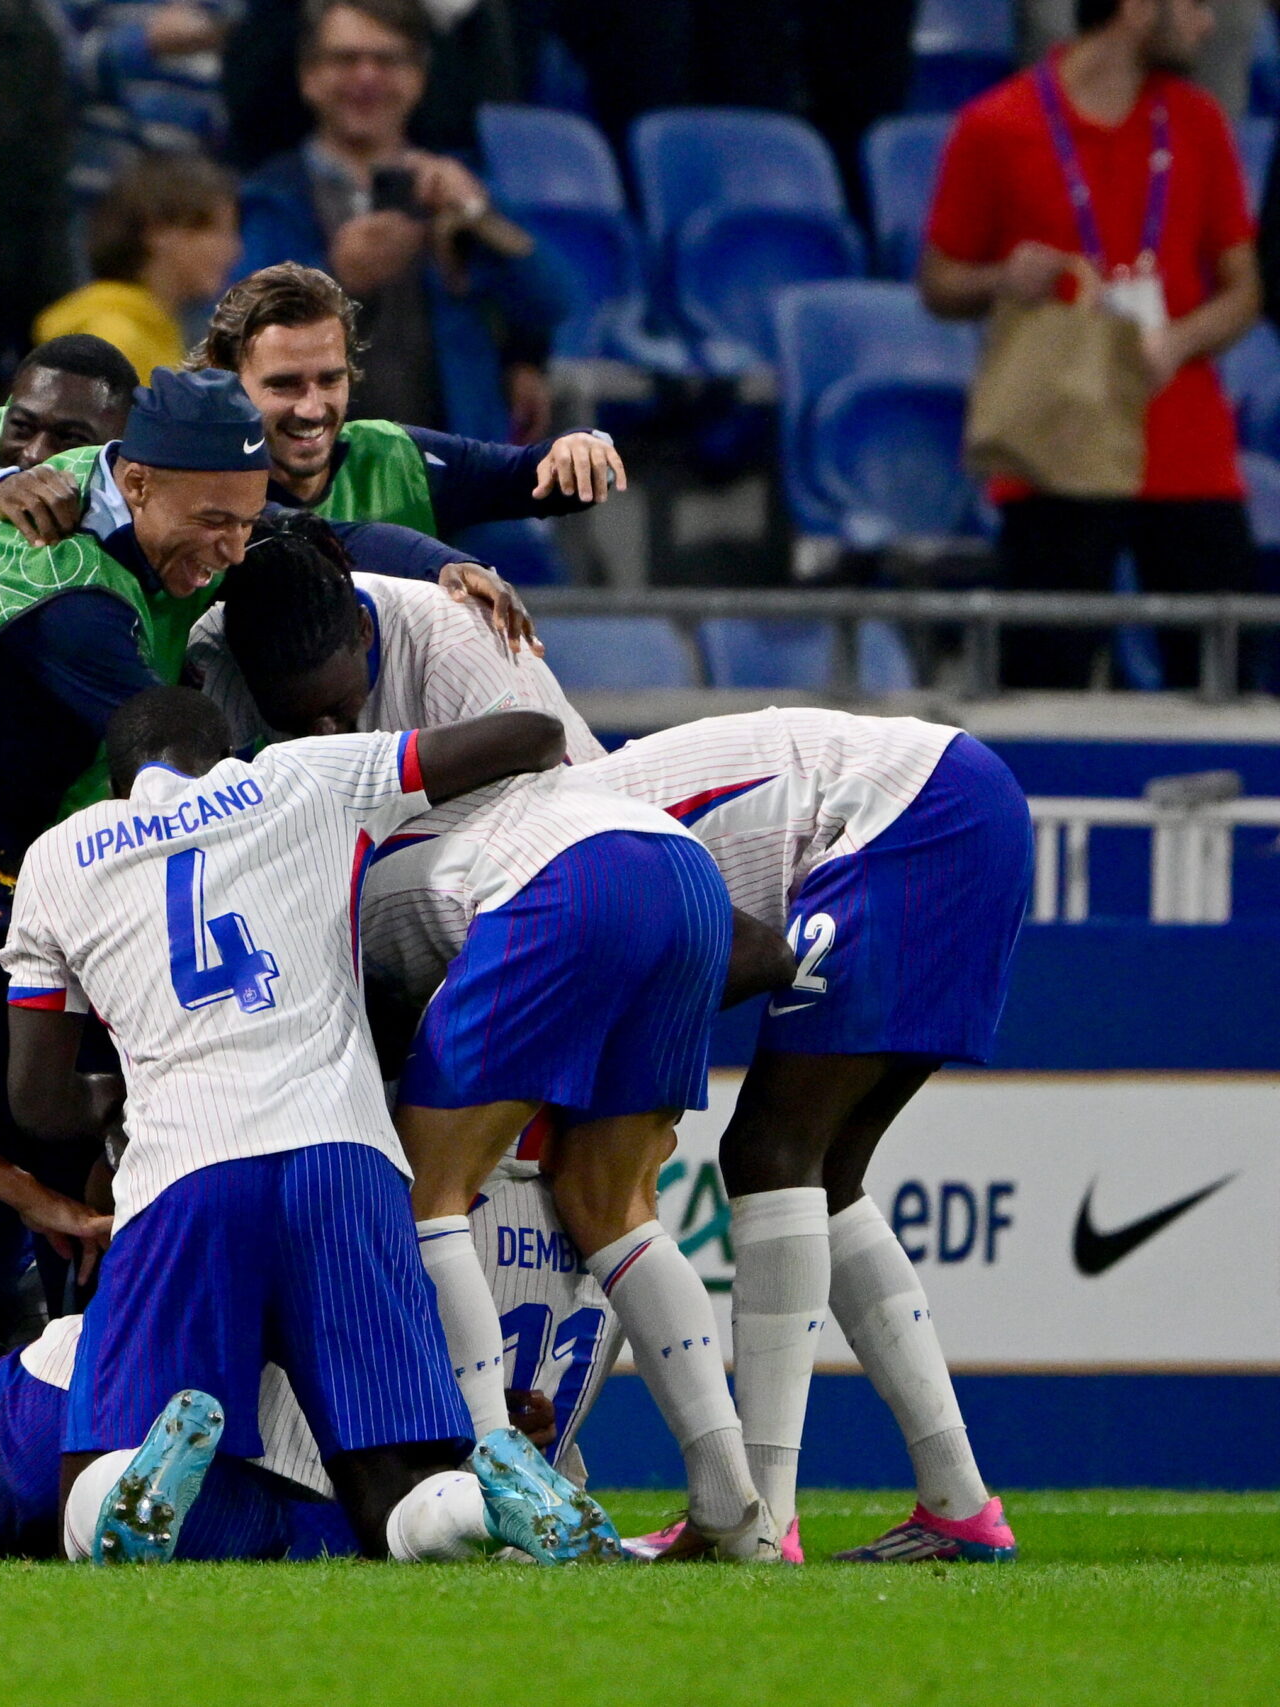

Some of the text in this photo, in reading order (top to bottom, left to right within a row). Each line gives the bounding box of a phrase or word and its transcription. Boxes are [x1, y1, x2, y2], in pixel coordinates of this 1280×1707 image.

[75, 778, 264, 868] UPAMECANO
[166, 847, 280, 1014] 4
[499, 1302, 606, 1468] 11
